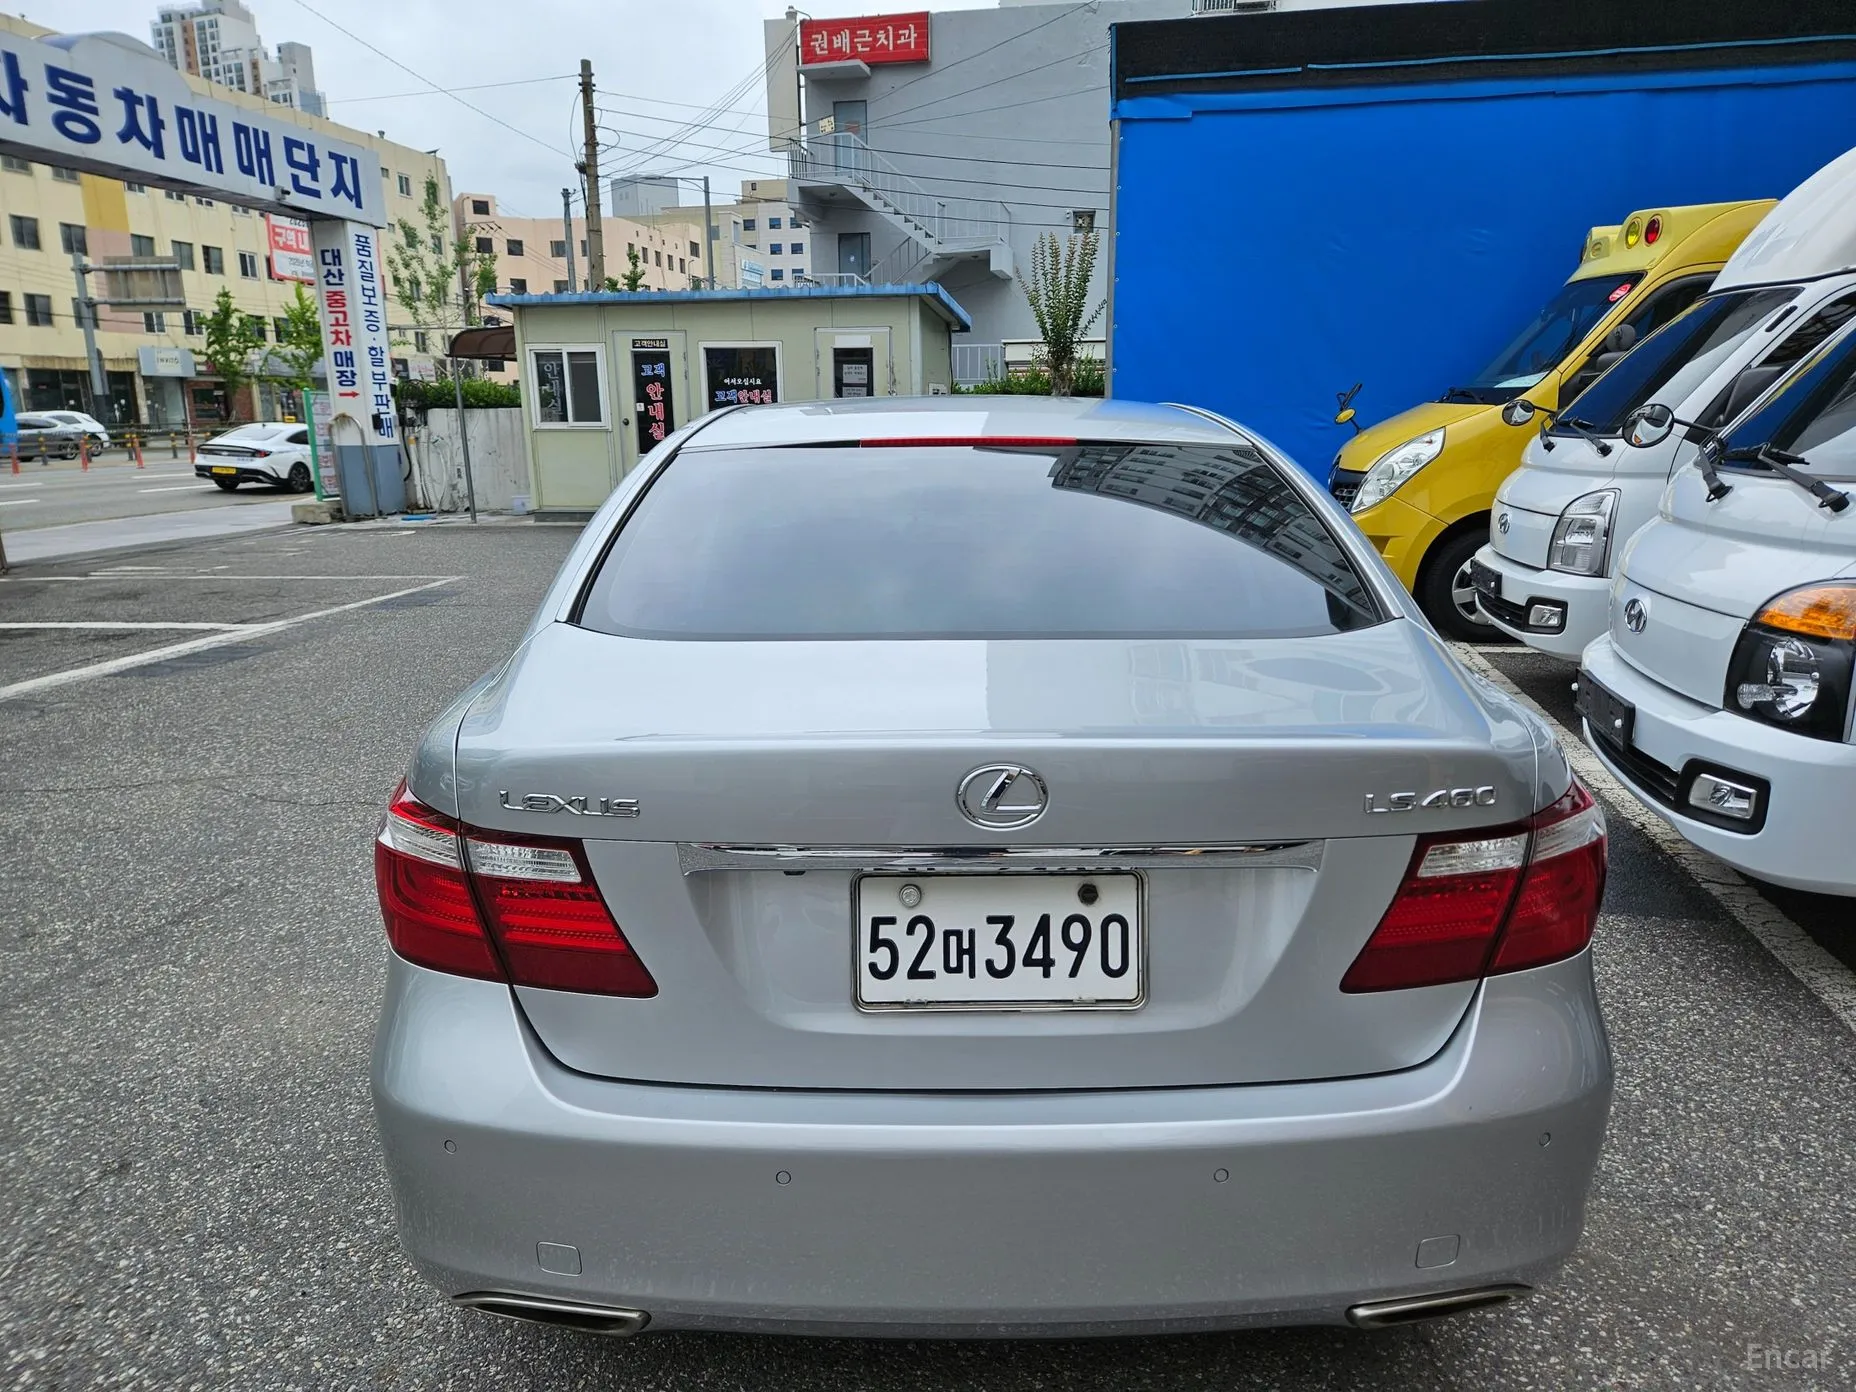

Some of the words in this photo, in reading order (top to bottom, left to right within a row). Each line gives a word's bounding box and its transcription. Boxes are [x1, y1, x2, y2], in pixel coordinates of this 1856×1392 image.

[810, 24, 918, 55] 권배근치과
[633, 340, 667, 348] 고객안내실
[640, 362, 666, 378] 고객
[645, 381, 665, 441] 안내실
[499, 790, 641, 818] LEXUS
[1364, 785, 1496, 814] LS460
